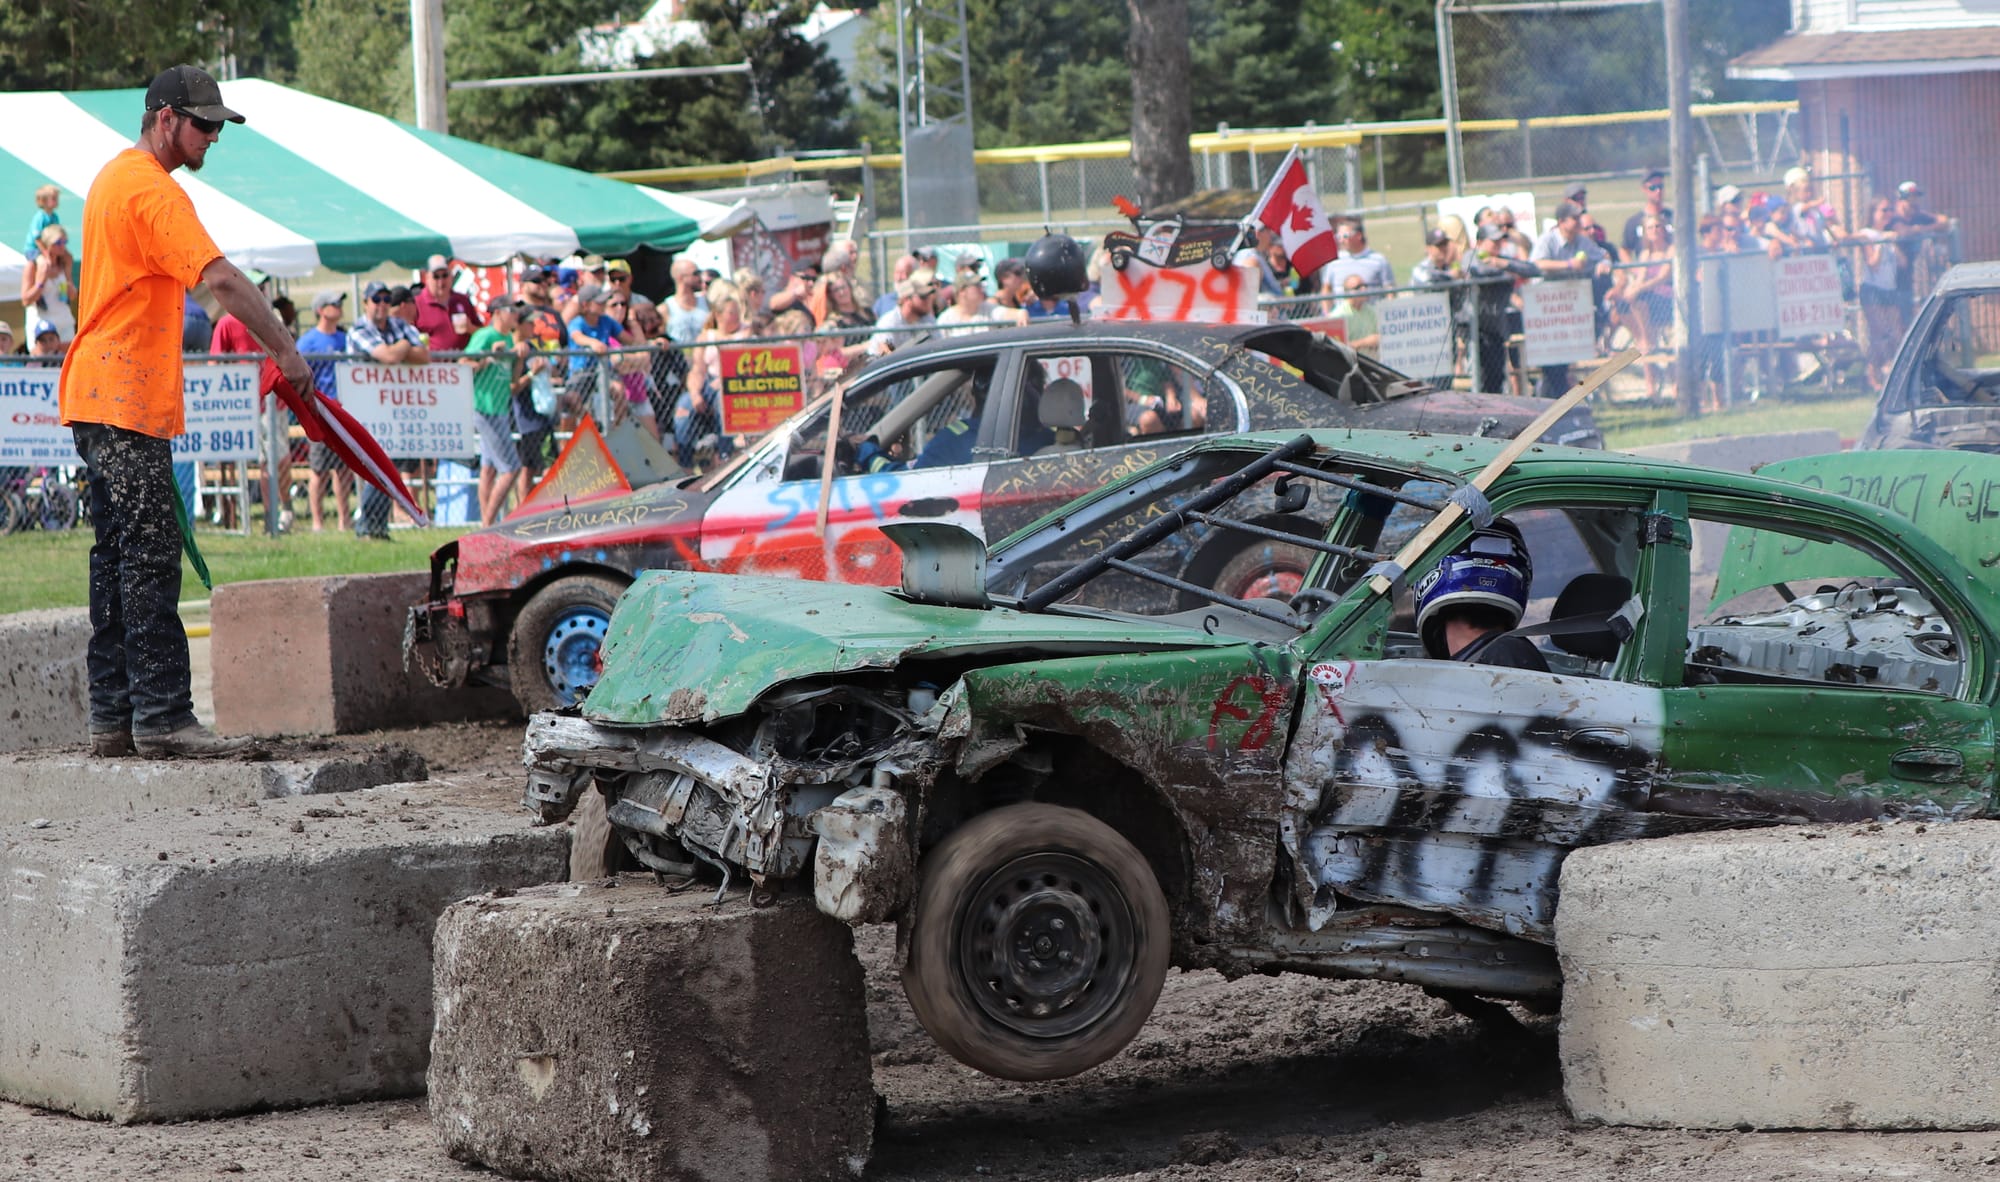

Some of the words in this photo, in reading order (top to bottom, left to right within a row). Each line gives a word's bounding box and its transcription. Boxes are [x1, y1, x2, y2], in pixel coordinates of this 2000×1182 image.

[1115, 266, 1242, 323] X79
[1411, 304, 1444, 318] FARM
[1543, 303, 1574, 314] FARM
[1381, 316, 1448, 335] EQUIPMENT
[1525, 313, 1593, 329] EQUIPMENT
[219, 372, 252, 392] Air
[351, 367, 461, 385] CHALMERS
[728, 376, 800, 393] ELECTRIC
[0, 379, 54, 402] ntry
[379, 388, 438, 406] FUELS
[1227, 367, 1310, 421] SALVAGE
[192, 397, 253, 412] SERVICE
[393, 408, 428, 421] ESSO
[363, 422, 393, 437] 19)
[398, 421, 463, 437] 343-3023
[545, 504, 649, 533] FORWARD
[1312, 664, 1343, 679] ONTARIO
